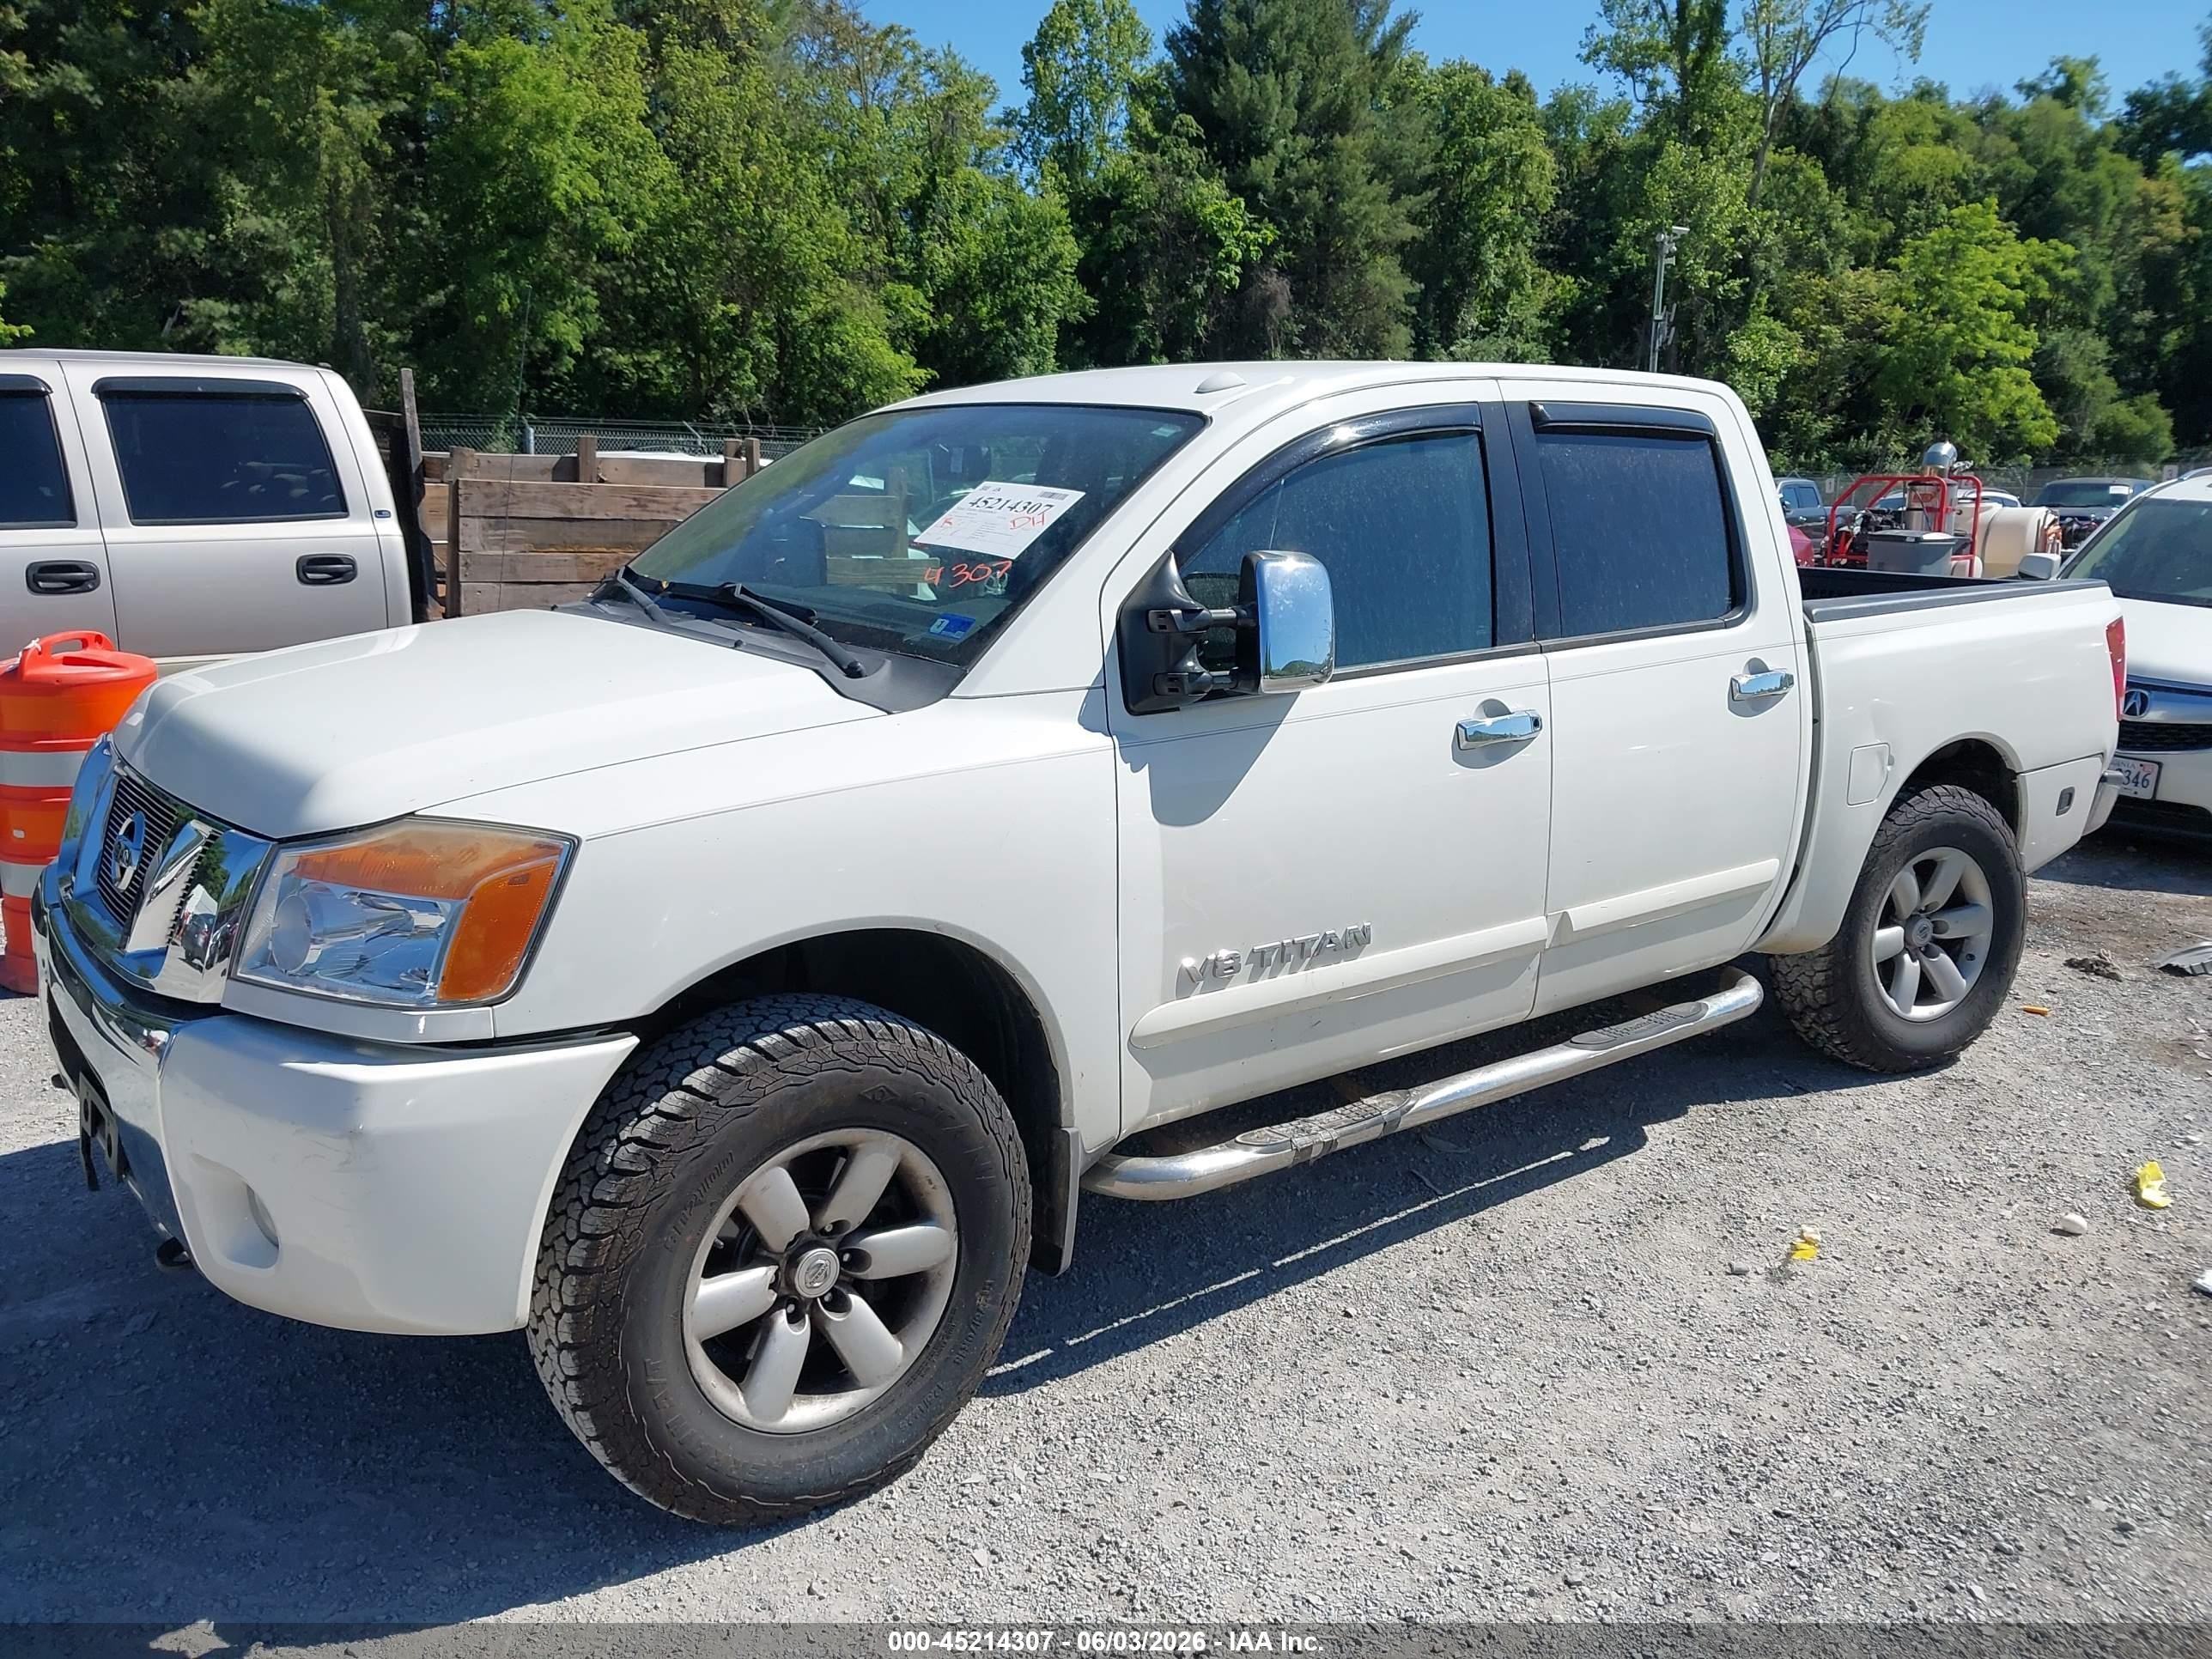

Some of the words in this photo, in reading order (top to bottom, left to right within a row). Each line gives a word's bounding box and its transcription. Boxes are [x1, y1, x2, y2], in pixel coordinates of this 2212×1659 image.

[969, 496, 1055, 516] 45214307
[1180, 949, 1242, 985] V8
[1251, 921, 1372, 969] TITAN
